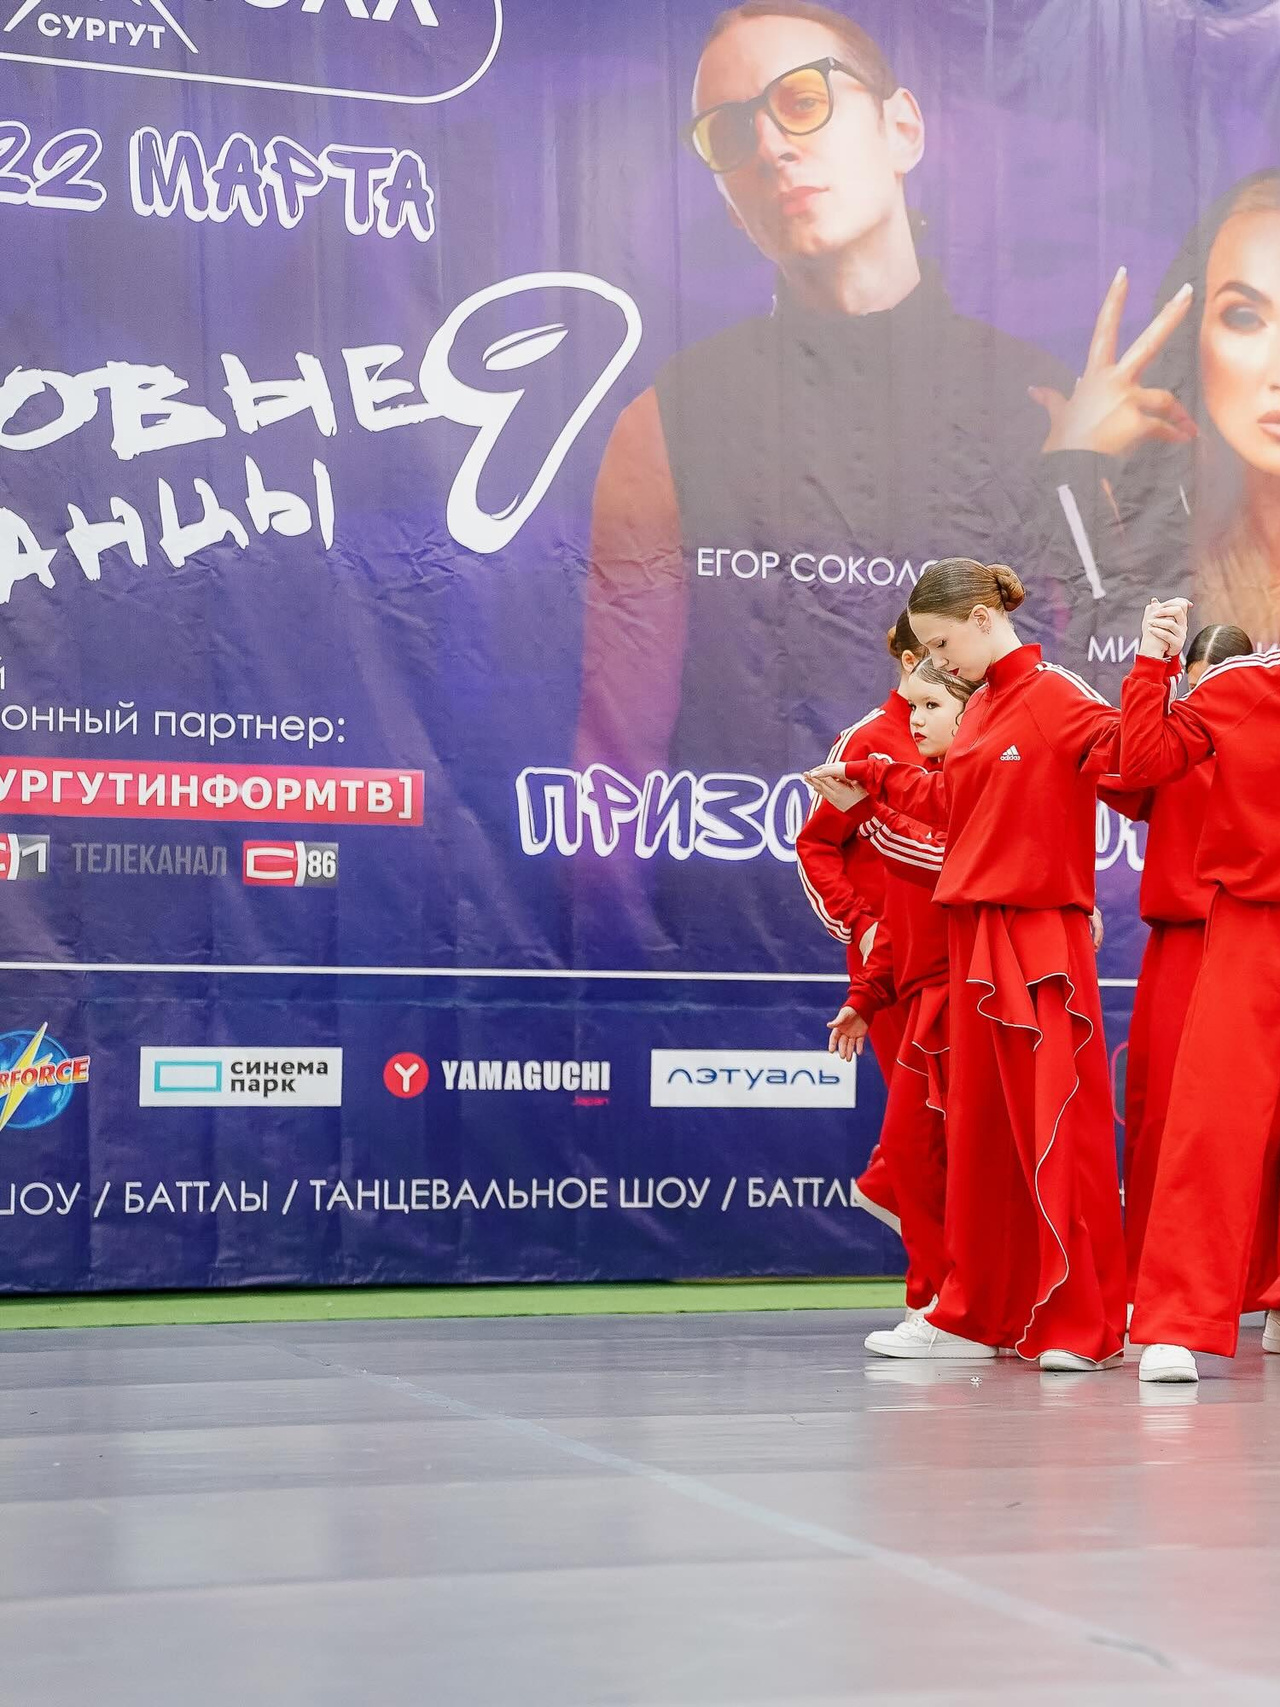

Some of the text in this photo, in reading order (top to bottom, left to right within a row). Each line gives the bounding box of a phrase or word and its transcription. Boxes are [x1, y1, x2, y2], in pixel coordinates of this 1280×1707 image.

[37, 13, 166, 50] СУРГУТ
[129, 126, 436, 242] МАРТА
[0, 343, 430, 461] ОВЫЕ
[0, 454, 336, 603] АНЦЫ
[697, 547, 940, 587] ЕГОР СОКОЛ
[0, 700, 347, 748] онный партнер:
[71, 842, 228, 877] ТЕЛЕКАНАЛ
[230, 1058, 329, 1076] синема
[441, 1060, 611, 1092] YAMAGUCHI
[230, 1078, 297, 1098] парк
[93, 1181, 111, 1218] /
[124, 1181, 268, 1213] БАТТЛЫ
[281, 1179, 299, 1215] /
[309, 1178, 607, 1216] ТАНЦЕВАЛЬНОЕ
[619, 1176, 711, 1210] ШОУ
[720, 1176, 737, 1212] /
